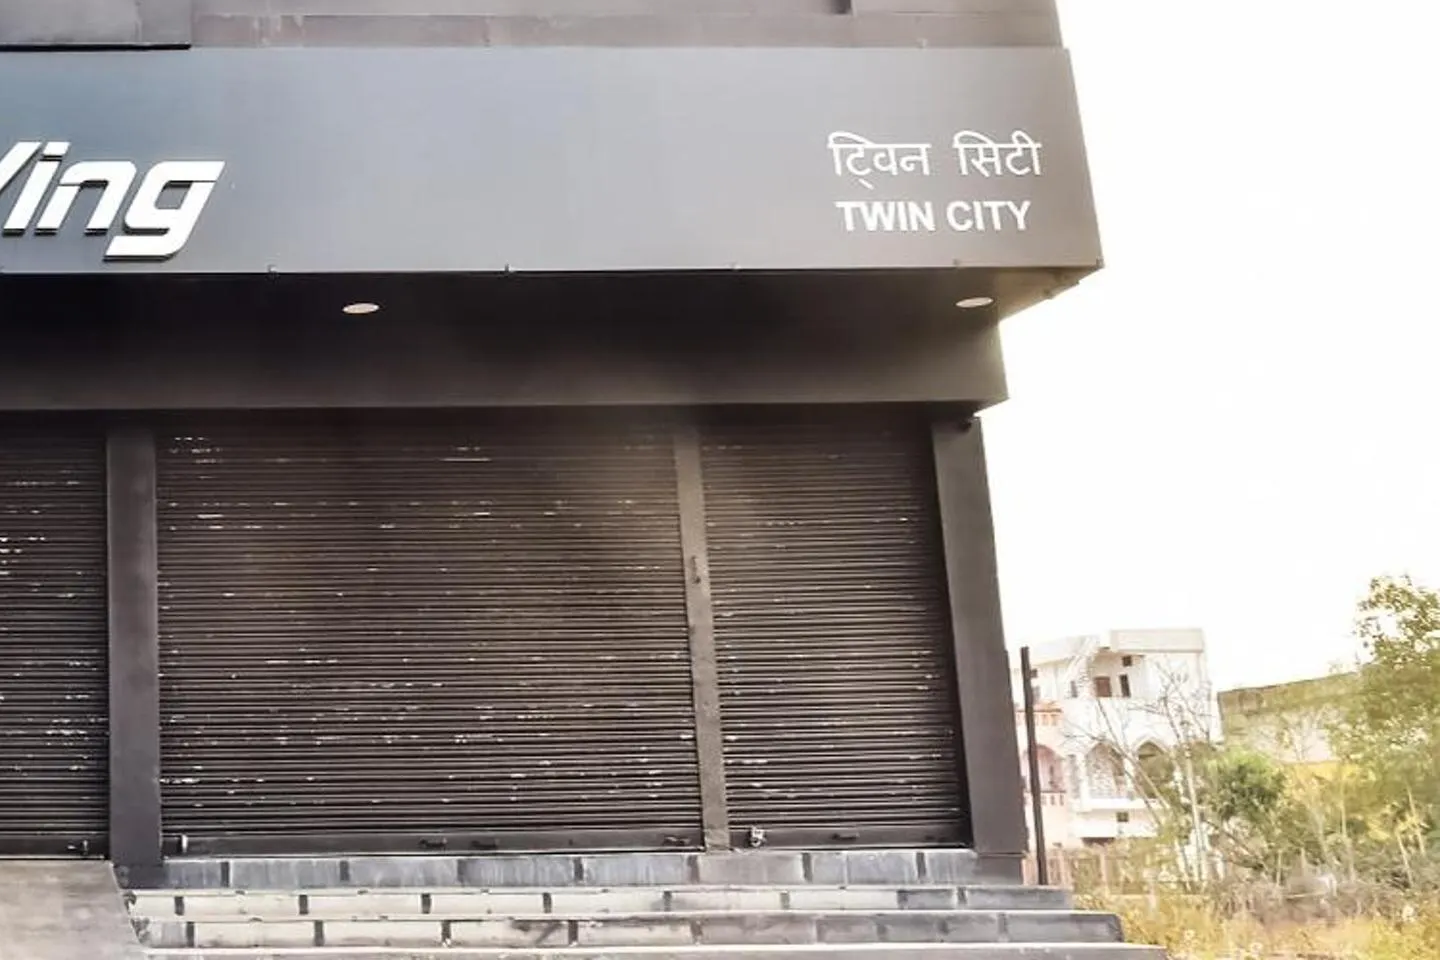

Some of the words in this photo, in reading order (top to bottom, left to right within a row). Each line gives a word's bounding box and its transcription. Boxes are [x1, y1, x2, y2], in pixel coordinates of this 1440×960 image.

[953, 129, 1043, 178] सिटी
[835, 201, 936, 232] TWIN
[946, 200, 1031, 232] CITY
